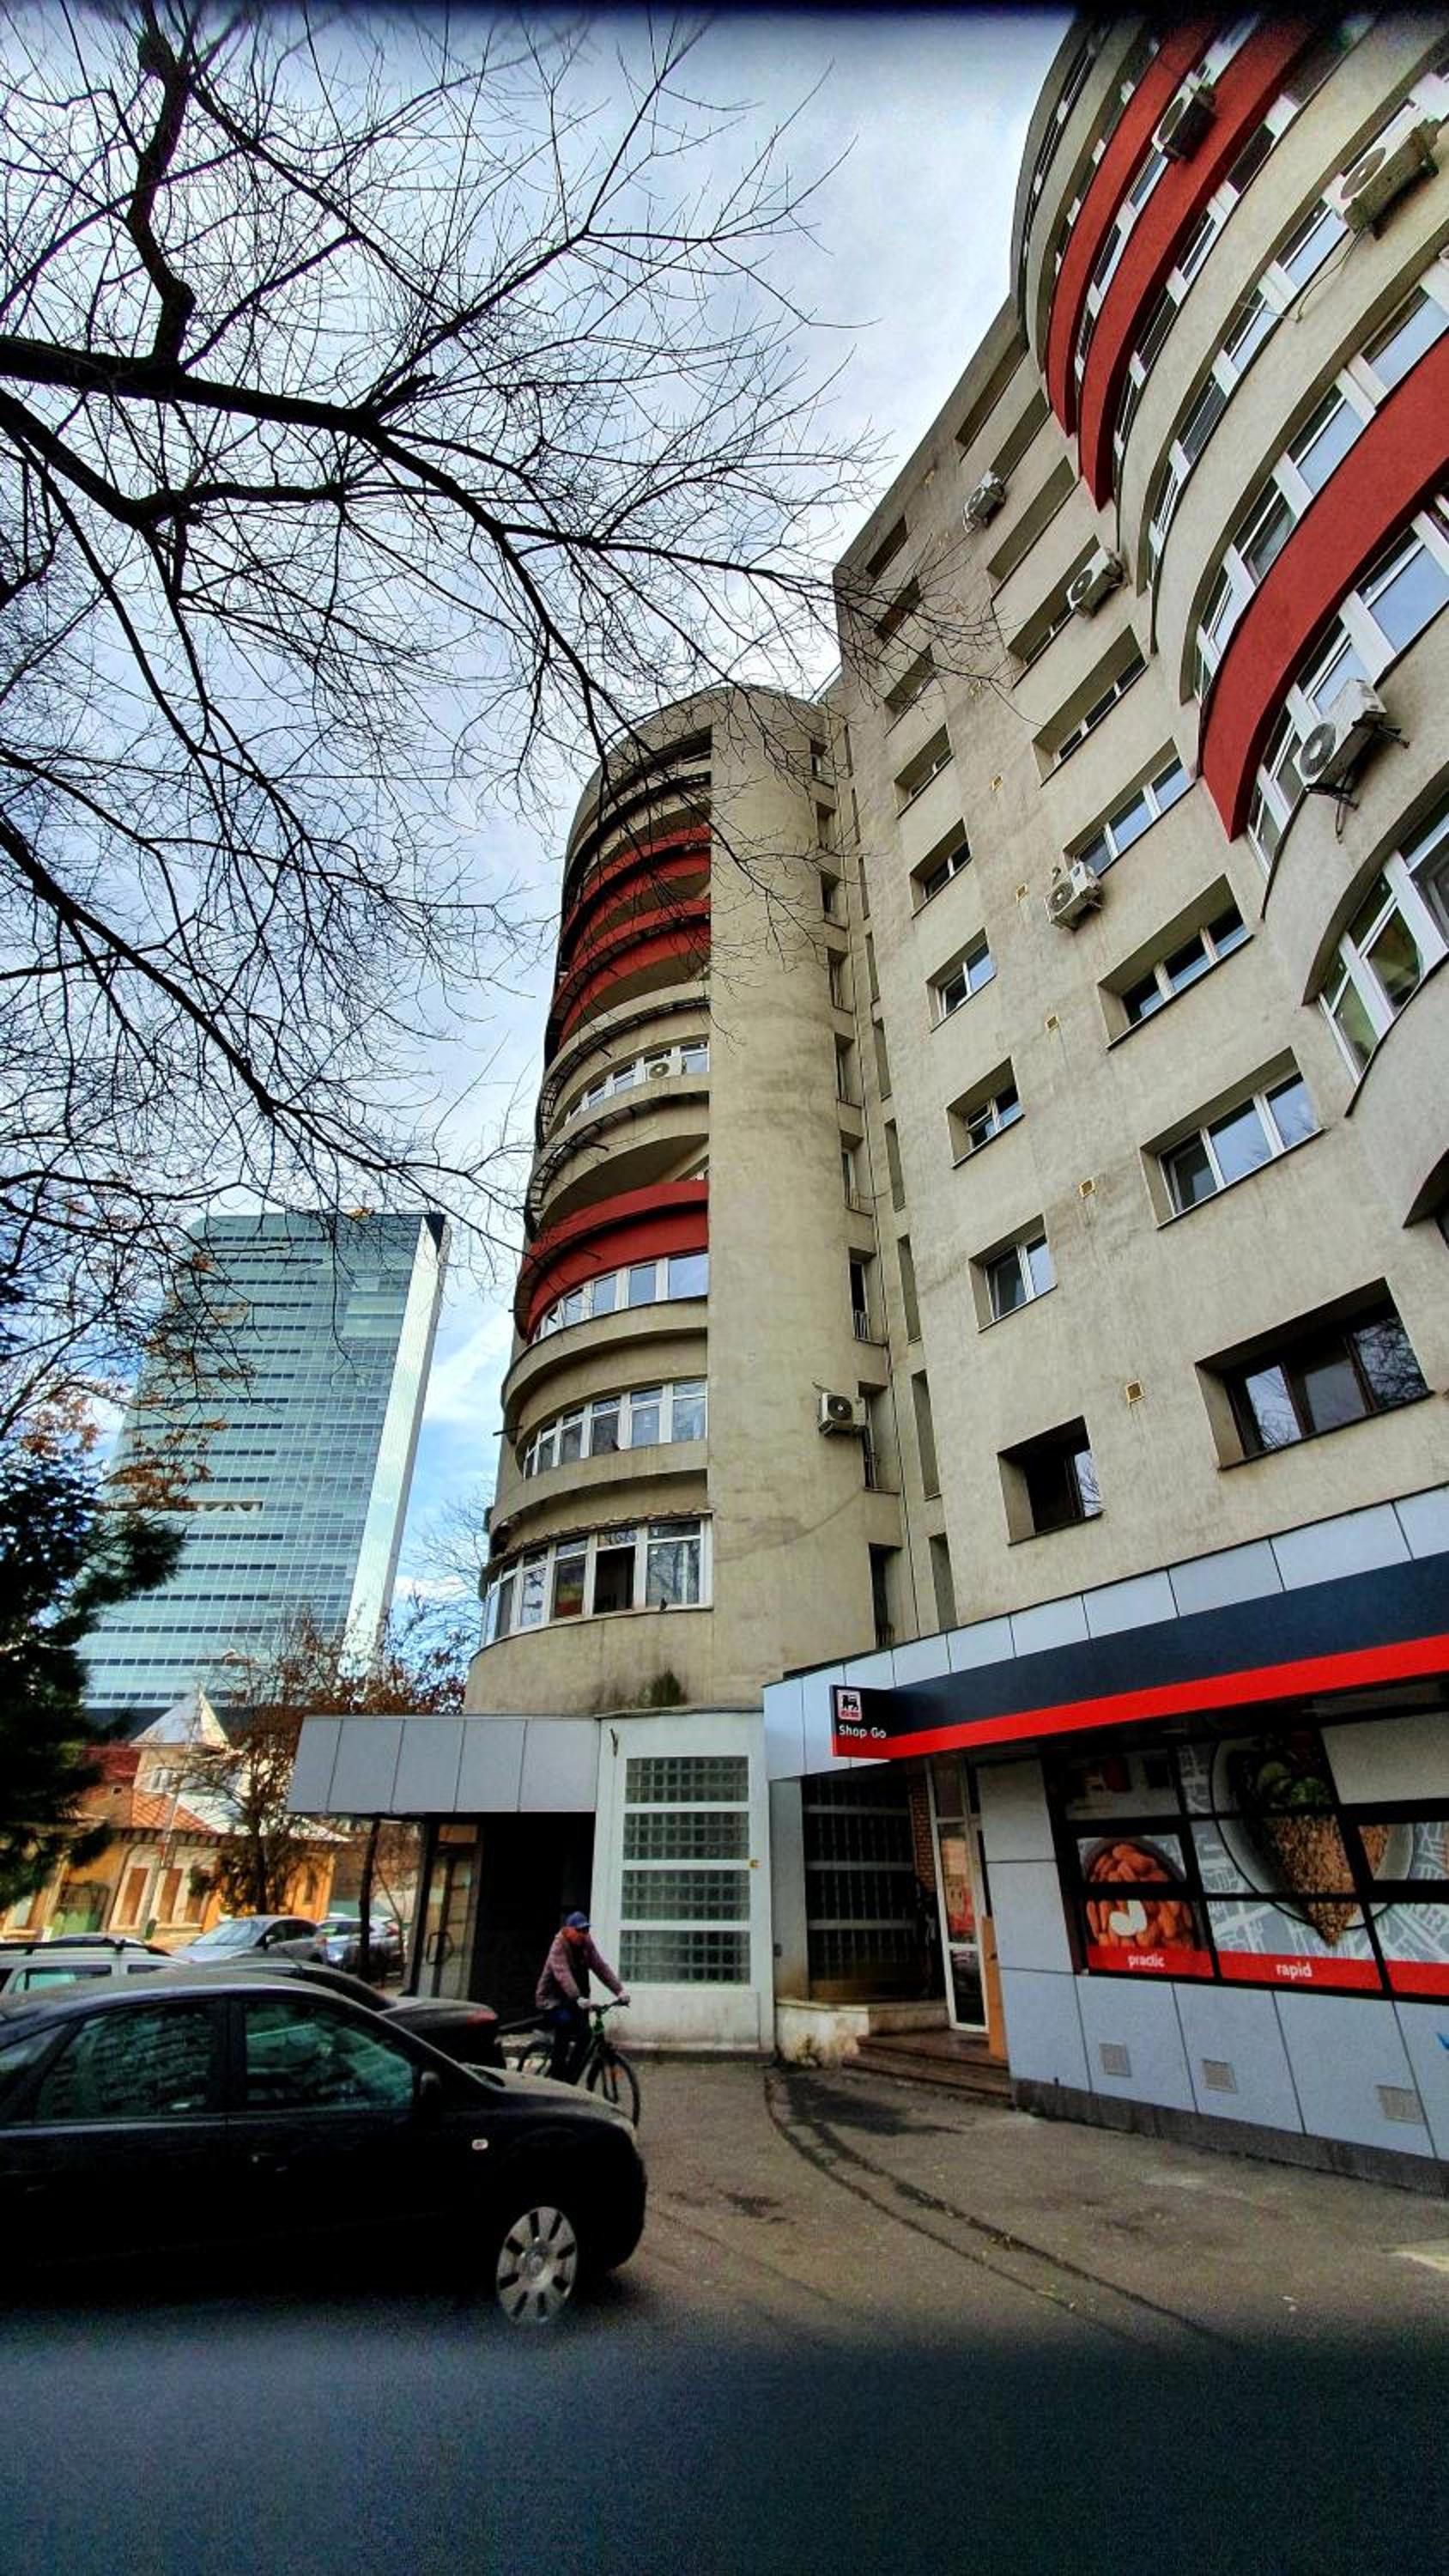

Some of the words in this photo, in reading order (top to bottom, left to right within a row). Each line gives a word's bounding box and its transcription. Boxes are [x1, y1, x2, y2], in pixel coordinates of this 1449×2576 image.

[839, 1724, 867, 1739] Shop
[870, 1727, 887, 1739] Go
[1276, 1960, 1313, 1980] rapid
